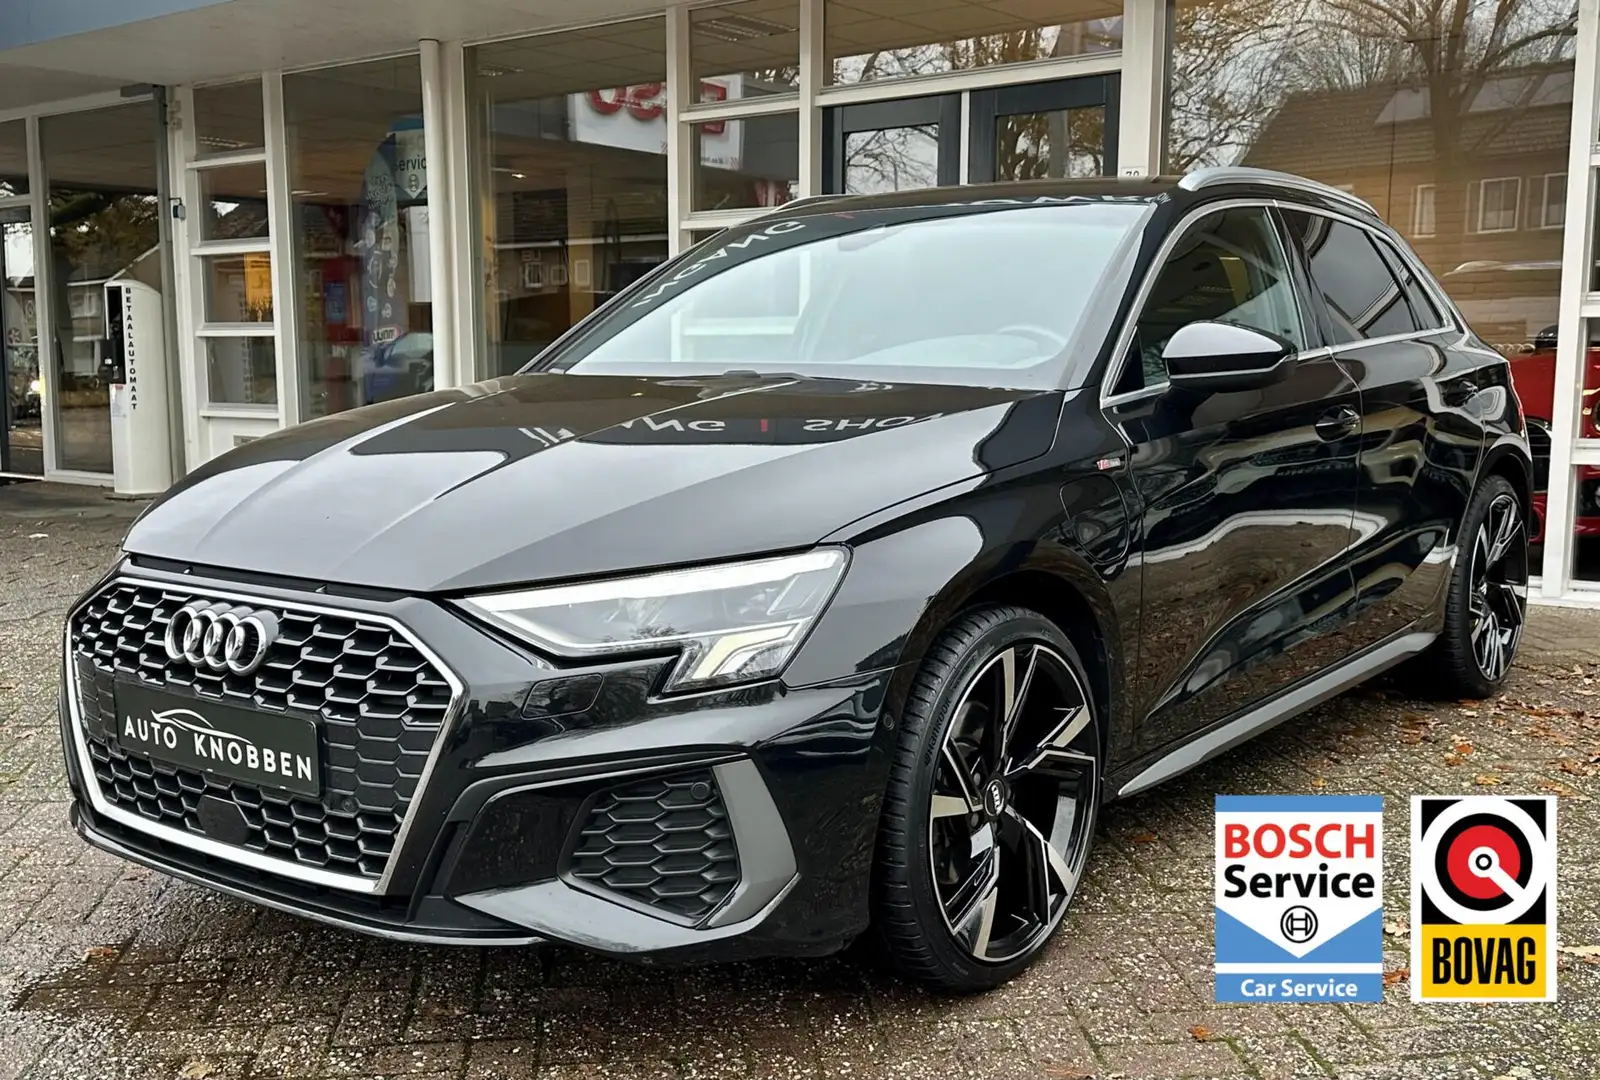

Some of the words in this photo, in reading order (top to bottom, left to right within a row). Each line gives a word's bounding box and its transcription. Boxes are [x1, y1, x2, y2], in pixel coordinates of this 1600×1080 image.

[125, 287, 138, 410] BETAALAUTOMAAT
[124, 715, 178, 749] AUTO
[193, 732, 313, 781] KNOBBEN
